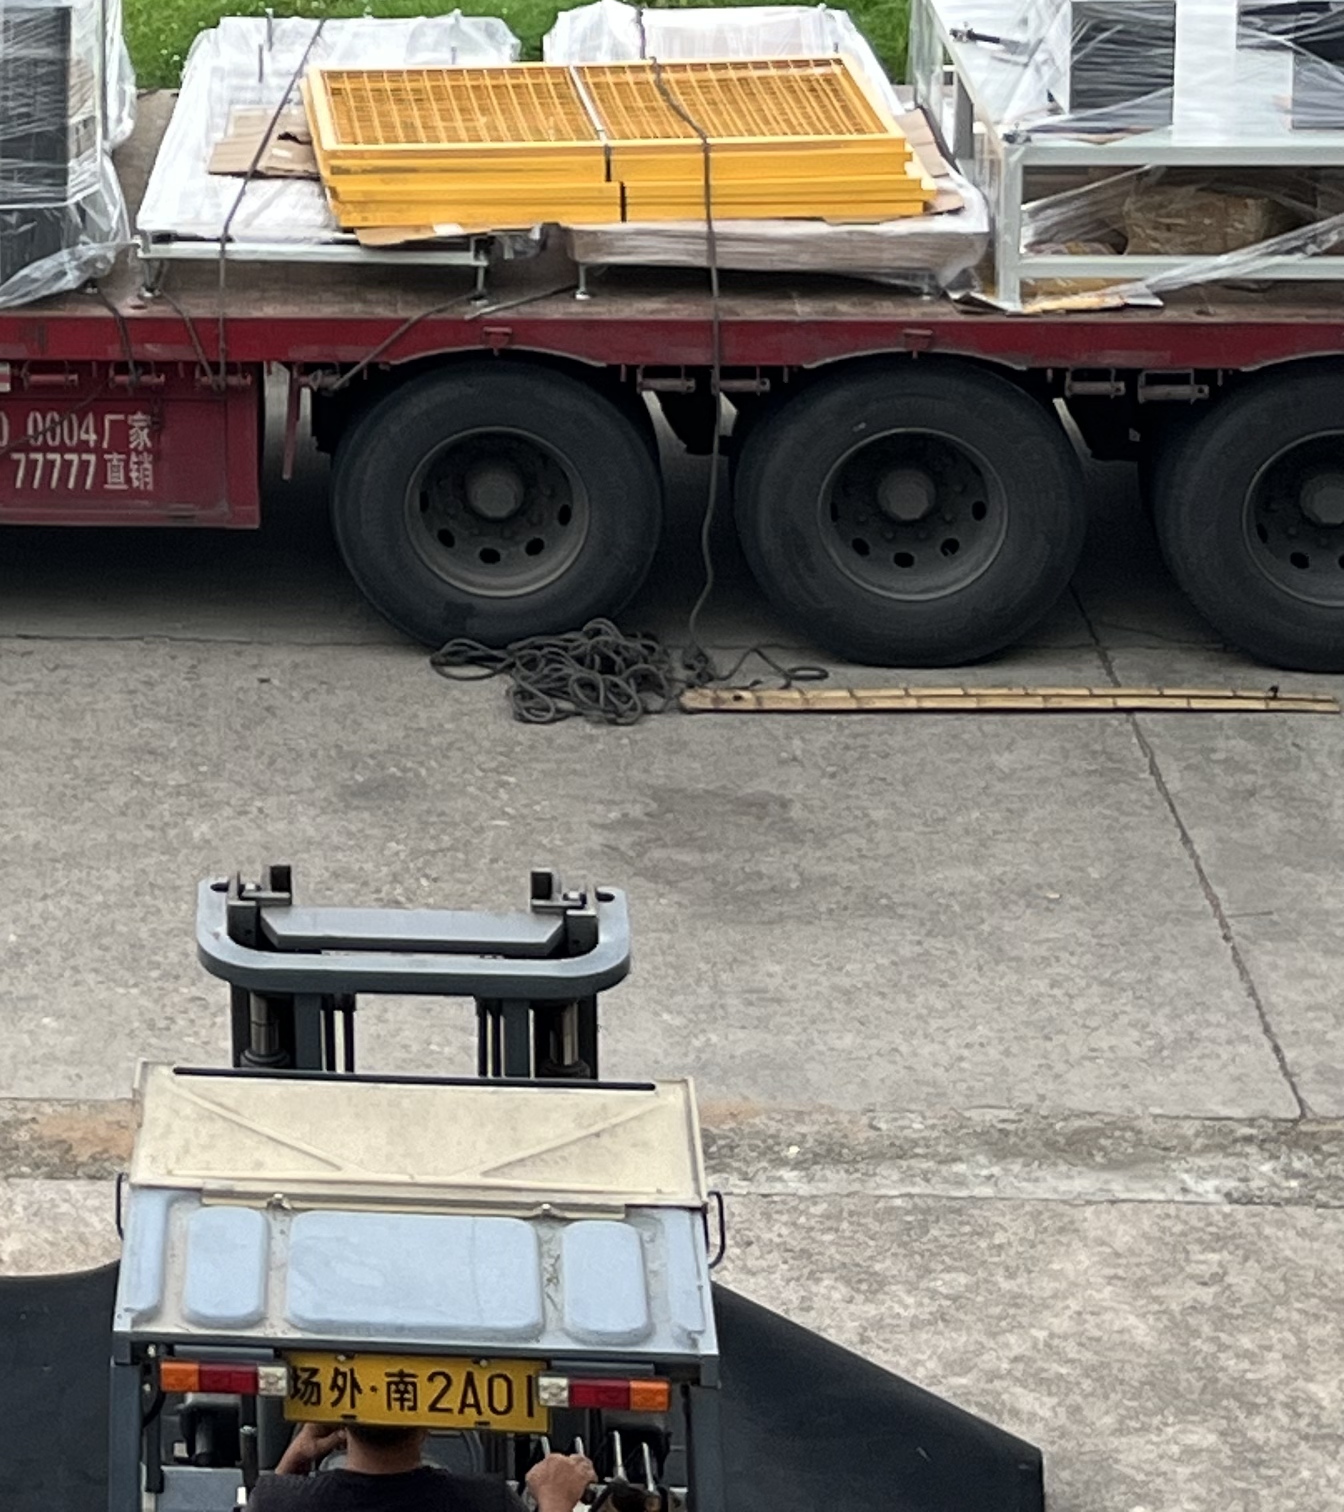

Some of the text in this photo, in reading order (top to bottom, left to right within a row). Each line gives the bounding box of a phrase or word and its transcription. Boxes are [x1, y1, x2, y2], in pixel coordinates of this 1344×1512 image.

[102, 410, 154, 451] 厂家
[10, 452, 97, 490] 77777
[103, 450, 155, 492] 直销
